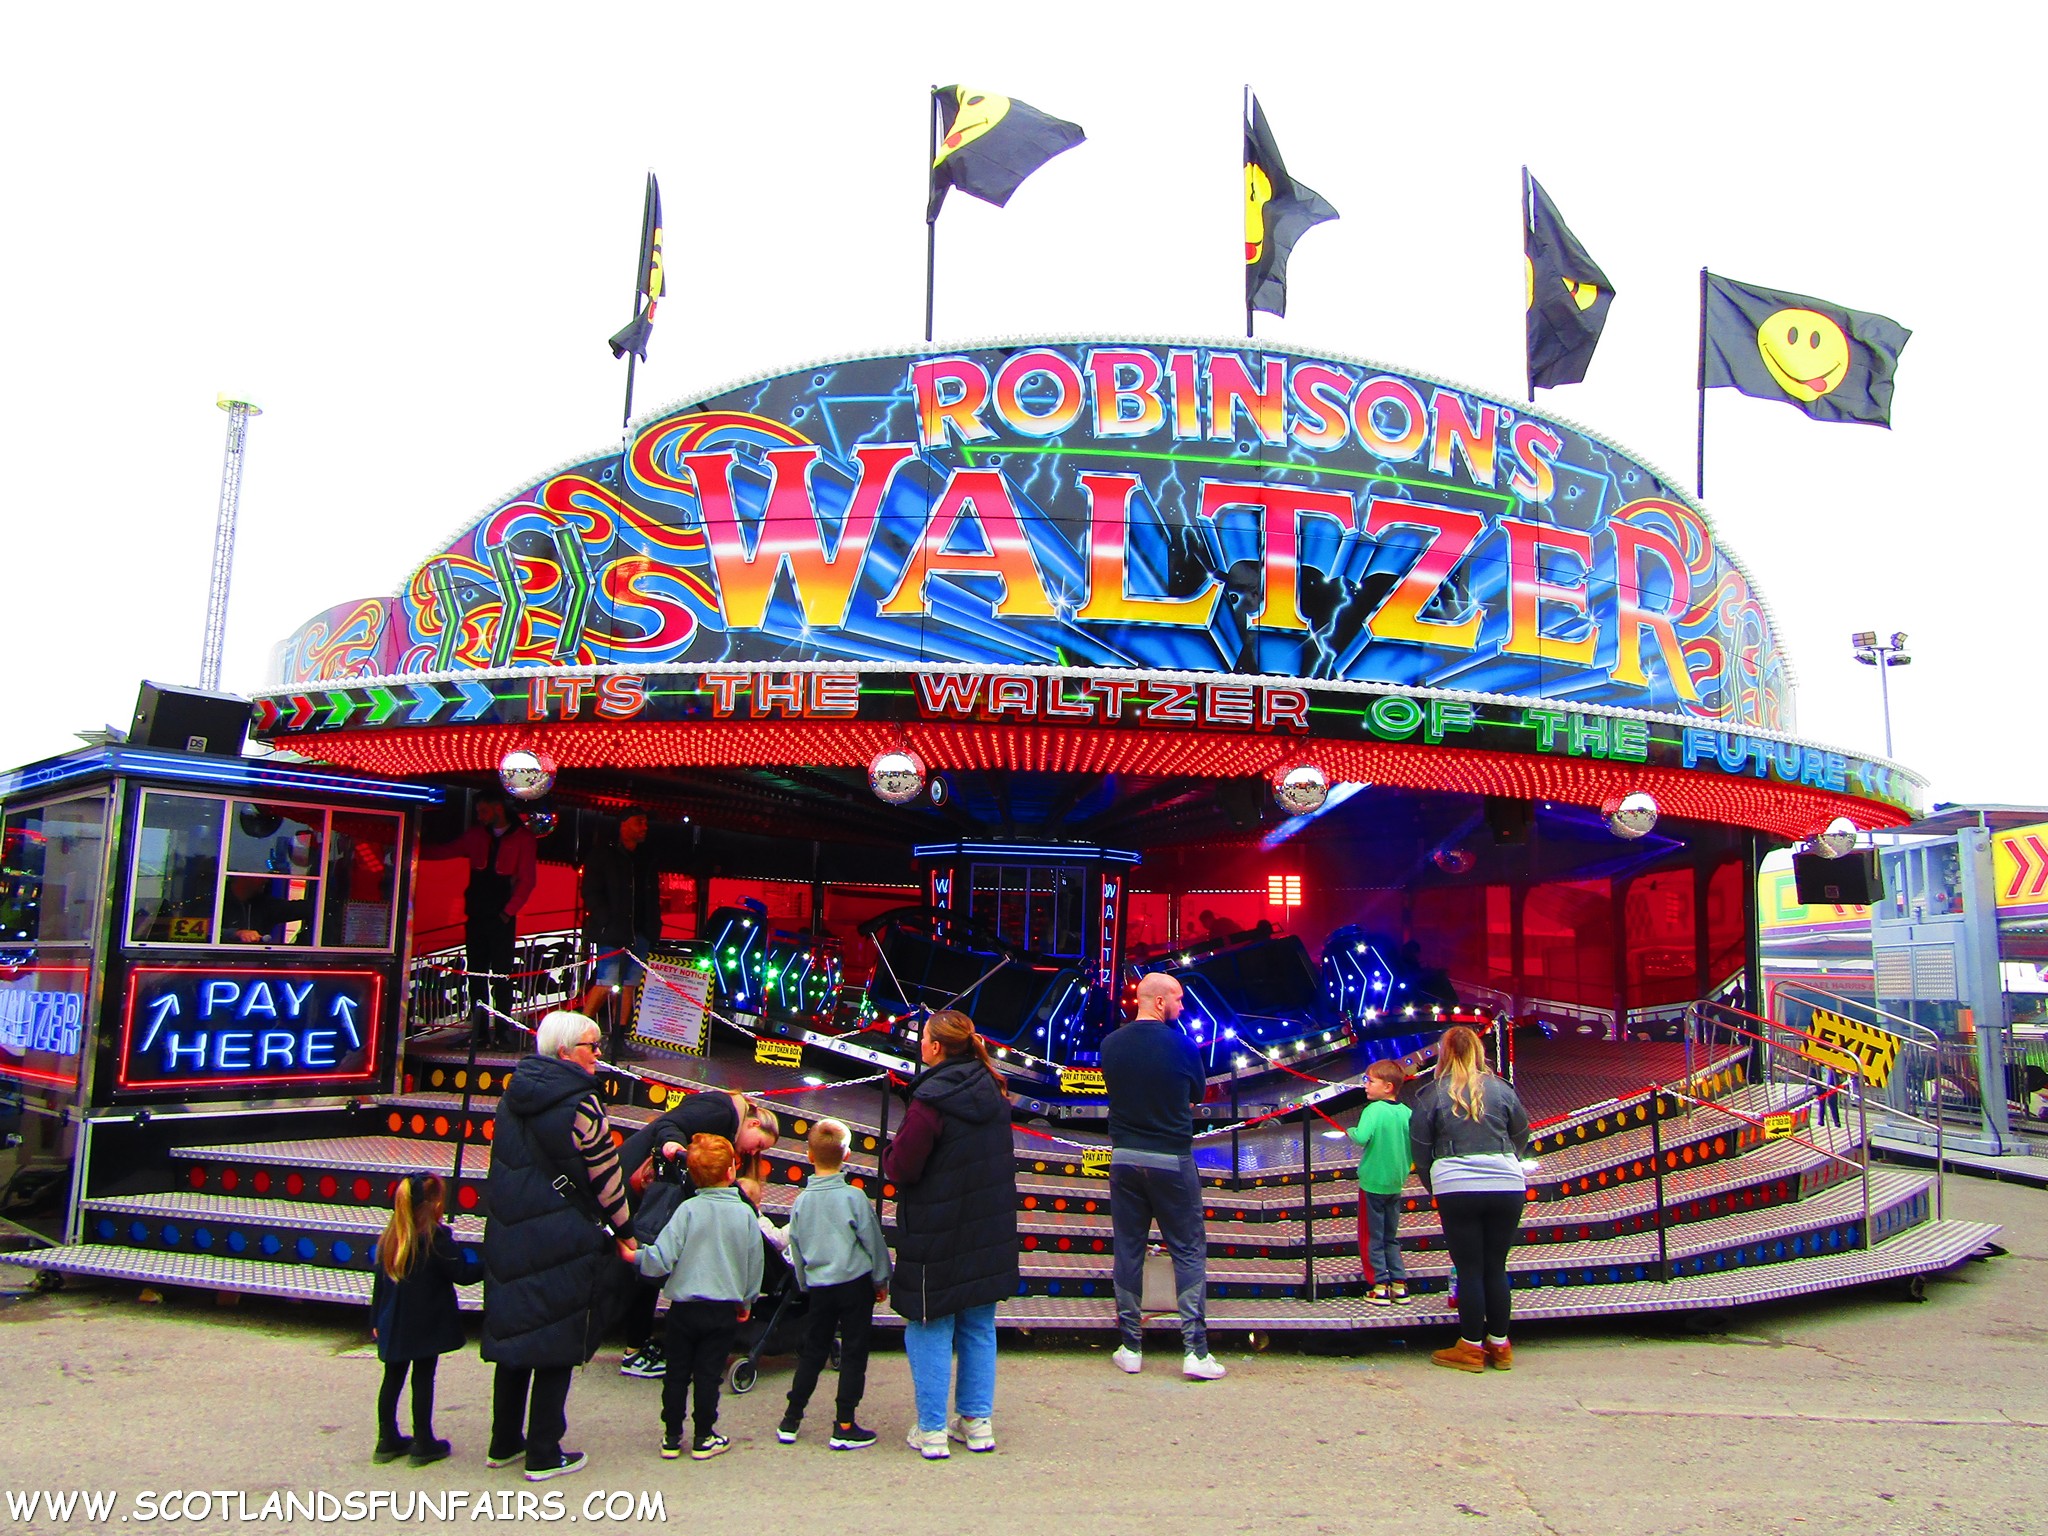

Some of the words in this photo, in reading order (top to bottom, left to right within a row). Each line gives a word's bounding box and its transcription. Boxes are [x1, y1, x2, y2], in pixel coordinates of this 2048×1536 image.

[908, 346, 1563, 504] ROBINSON'S
[678, 442, 1702, 704] WALTZER
[528, 674, 648, 721] ITS
[699, 672, 860, 719] THE
[910, 671, 1311, 734] WALTZER
[1363, 694, 1474, 744] OF
[1522, 706, 1649, 765] THE
[1682, 727, 1847, 792] FUTURE
[650, 962, 678, 975] SAFETY
[680, 967, 708, 981] NOTICE
[203, 980, 315, 1018] PAY
[169, 1029, 338, 1069] HERE
[758, 1043, 767, 1051] PAY
[767, 1044, 774, 1052] AT
[774, 1045, 790, 1054] TOKEN
[1815, 1027, 1884, 1067] EXIT
[1063, 1072, 1072, 1080] PAY
[1080, 1073, 1096, 1082] TOKEN
[670, 1093, 681, 1102] PAY
[1085, 1153, 1095, 1161] PAY
[1096, 1153, 1104, 1161] AT
